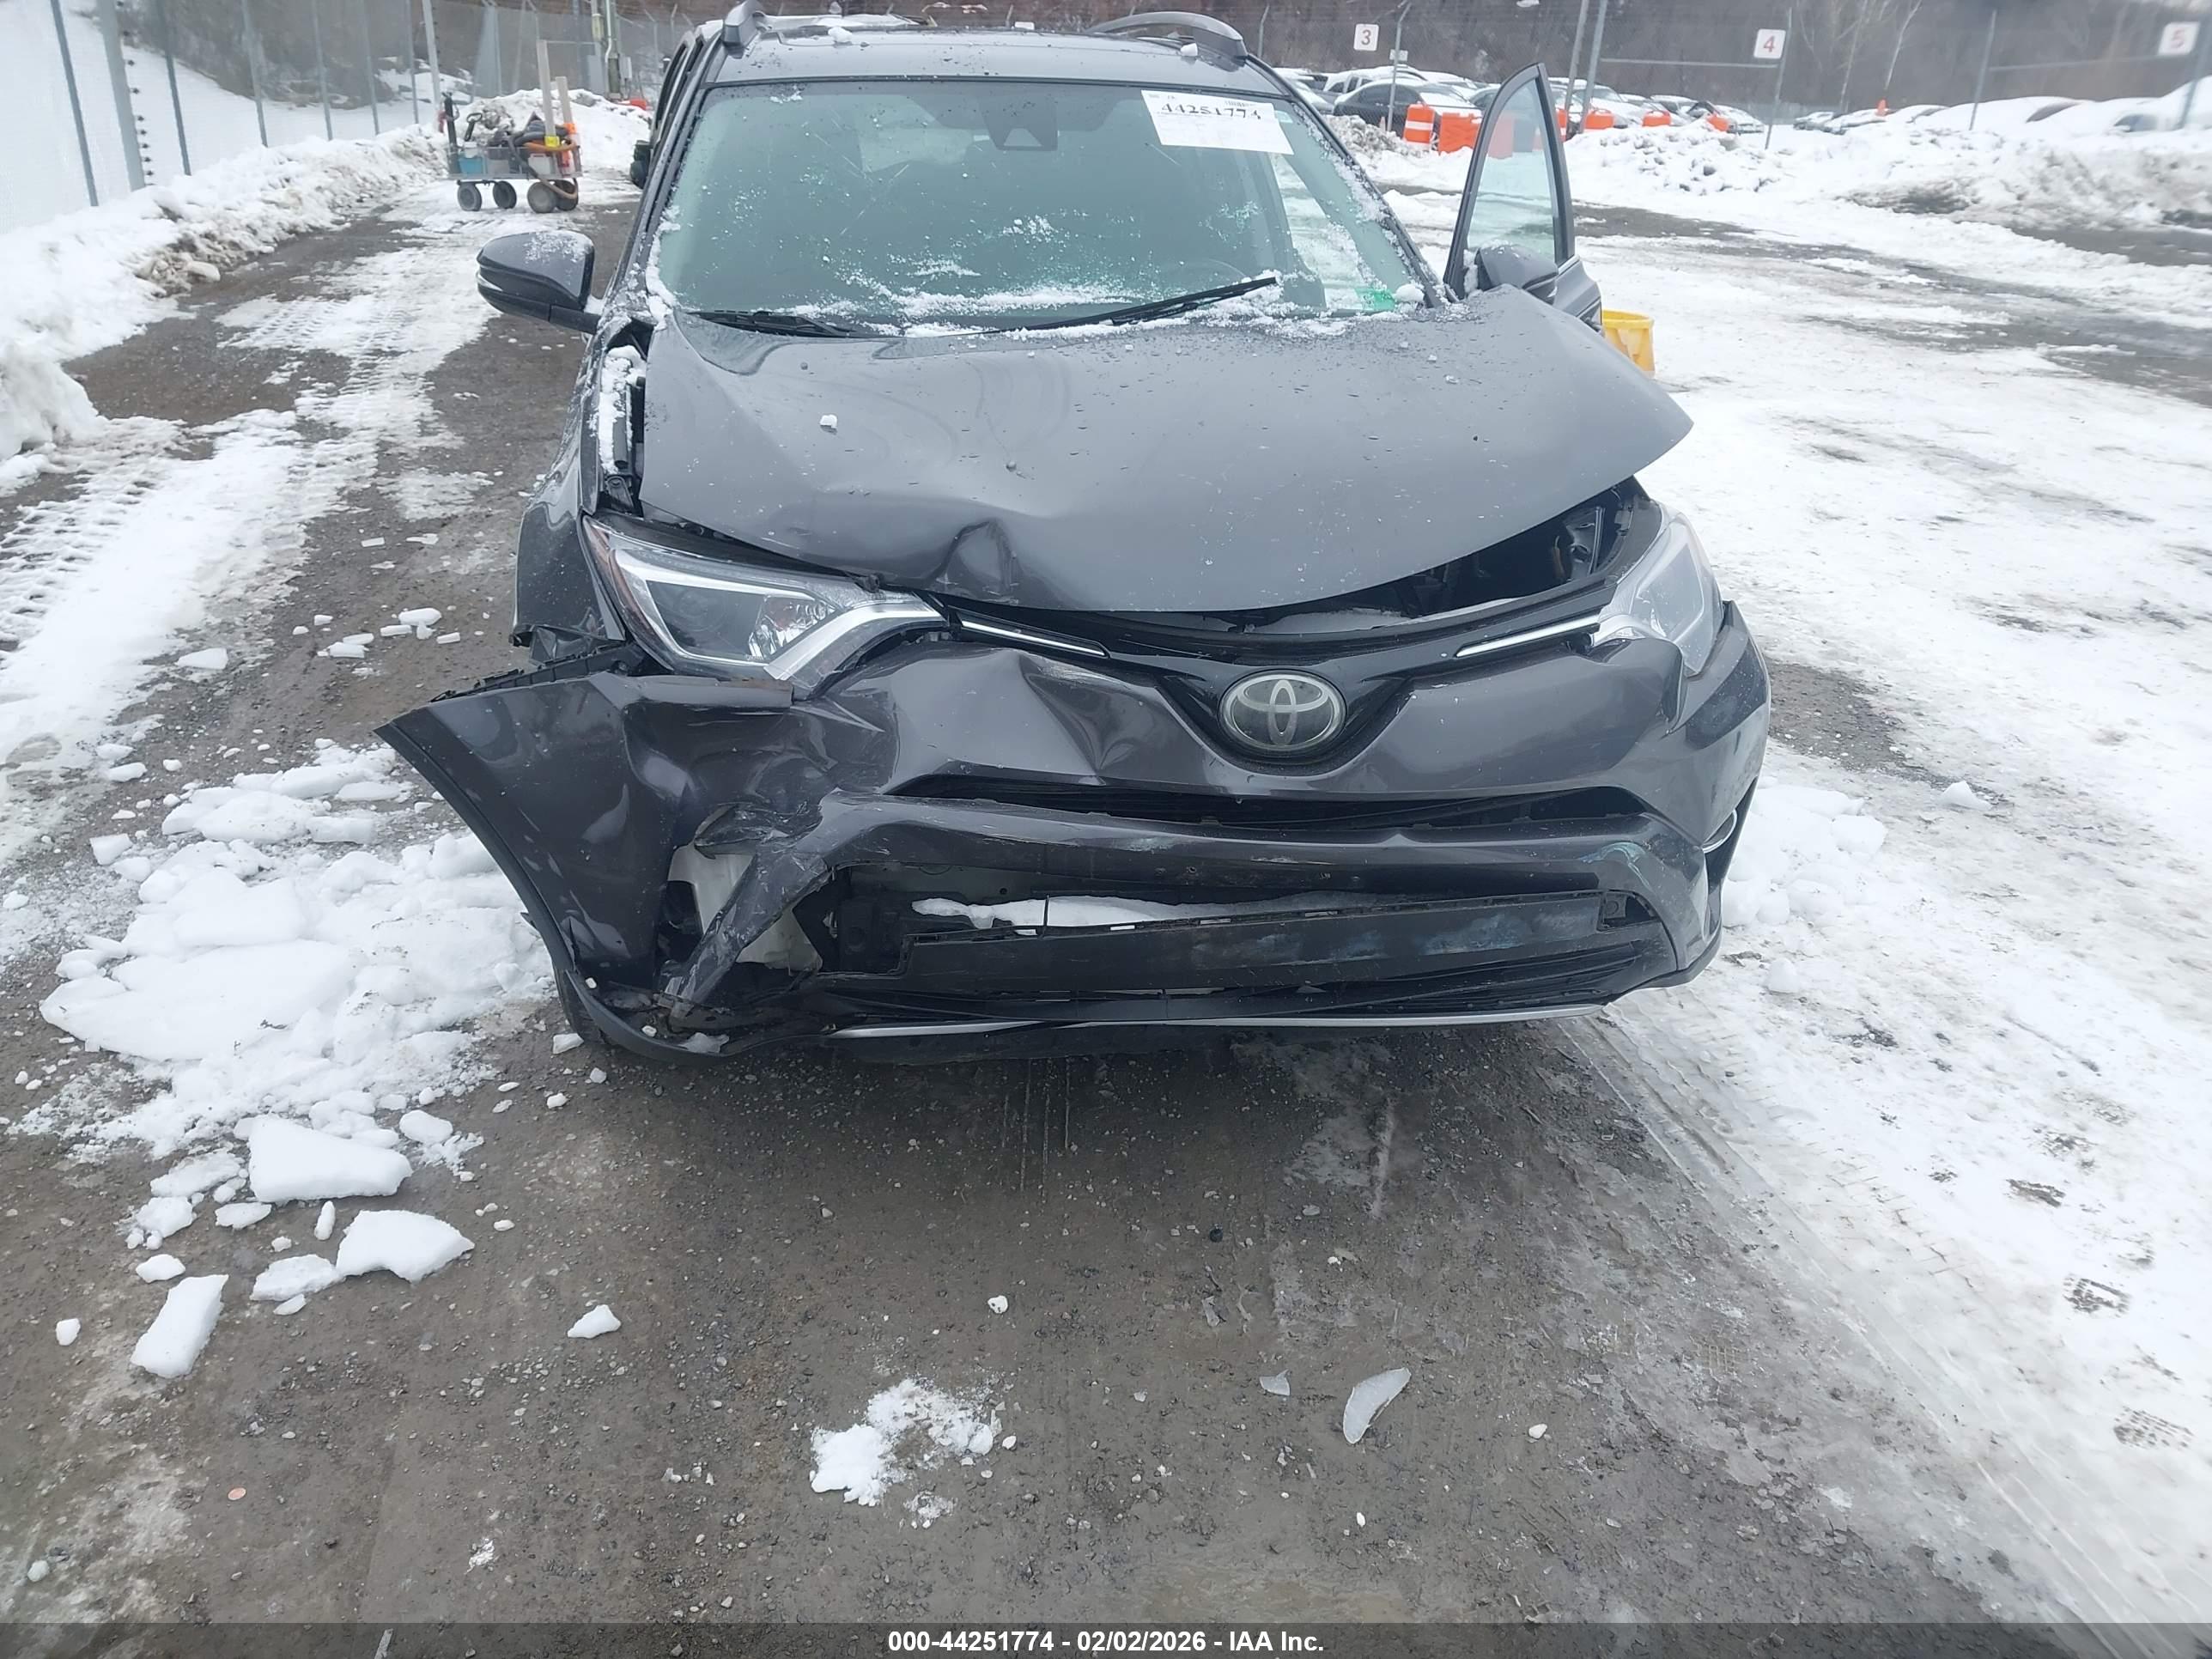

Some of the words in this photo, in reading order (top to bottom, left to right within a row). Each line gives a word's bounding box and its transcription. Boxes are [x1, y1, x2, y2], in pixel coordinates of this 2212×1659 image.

[1361, 29, 1371, 46] 3
[1763, 35, 1775, 52] 4
[2171, 29, 2185, 48] 5
